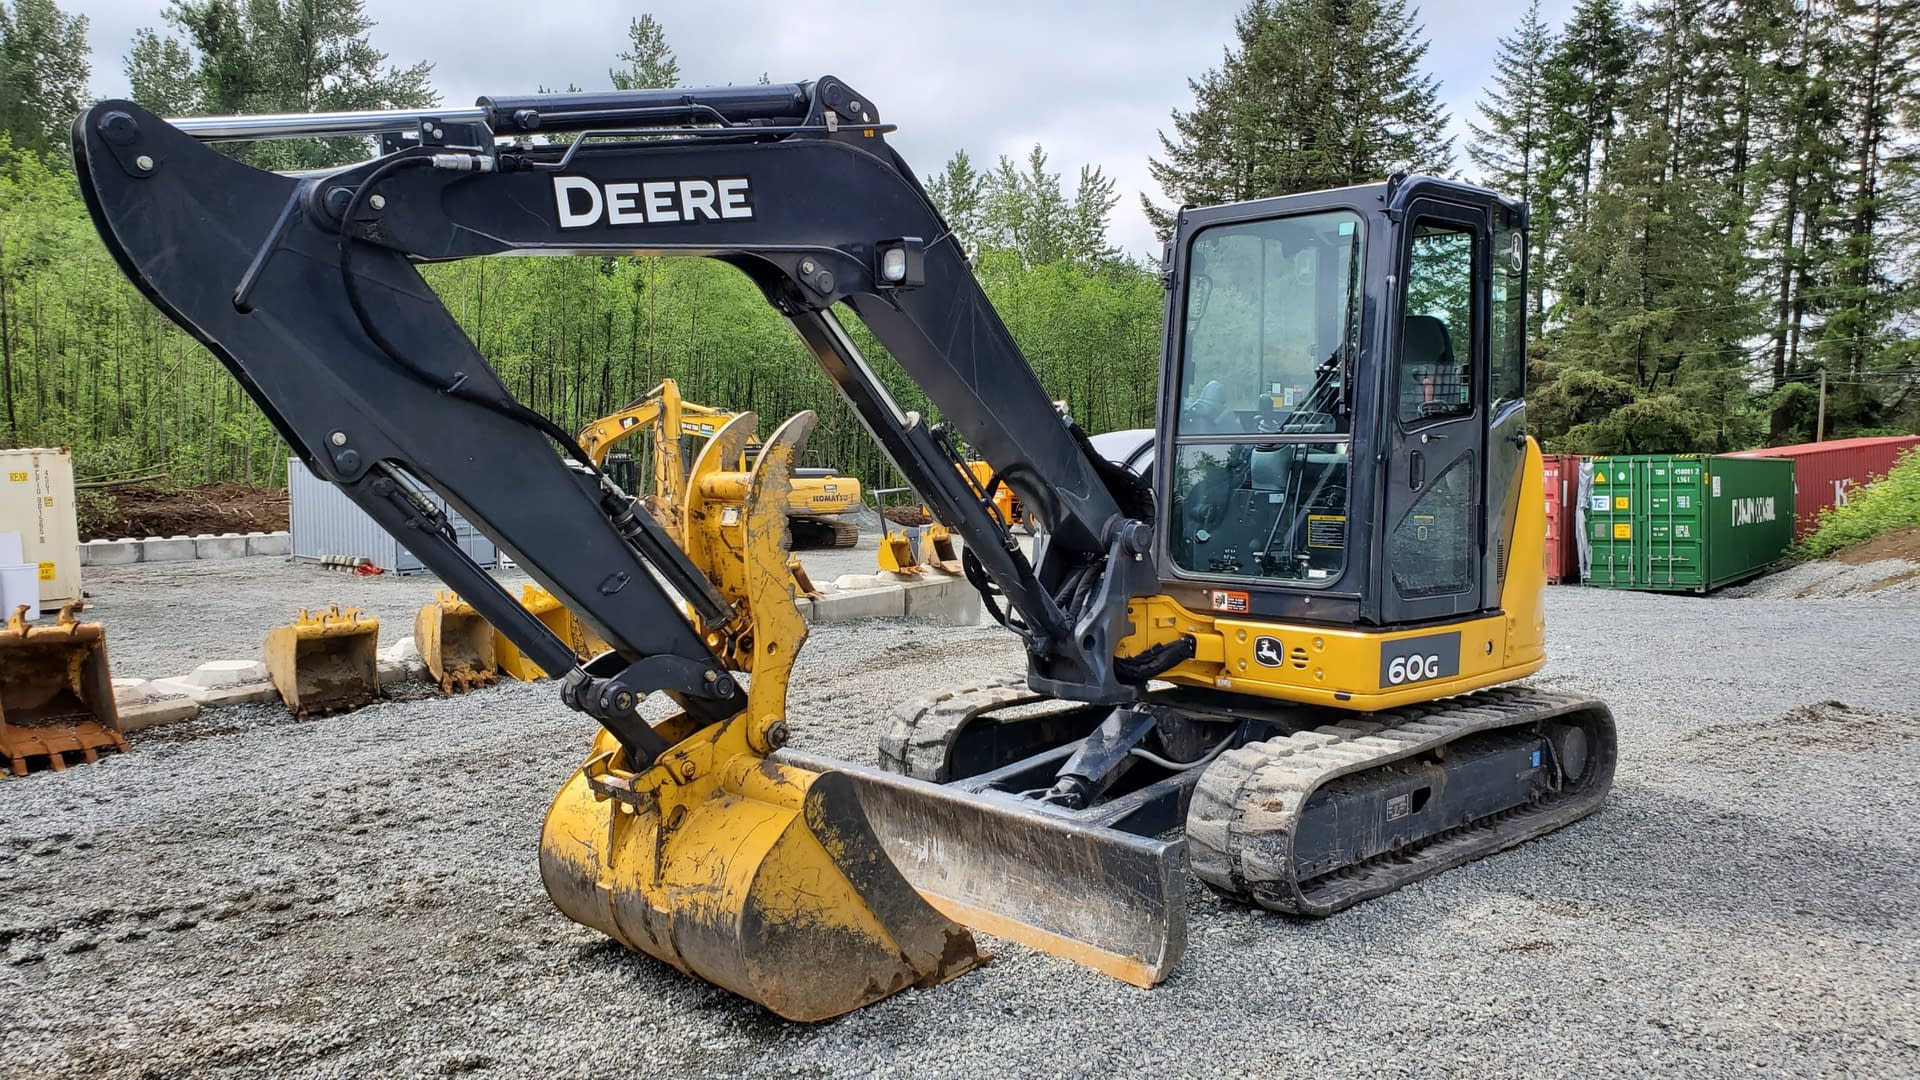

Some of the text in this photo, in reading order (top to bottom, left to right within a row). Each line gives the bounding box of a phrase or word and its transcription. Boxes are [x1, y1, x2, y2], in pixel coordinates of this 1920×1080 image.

[553, 176, 752, 228] DEERE
[812, 494, 849, 503] KOMATSU
[1388, 654, 1439, 685] 60G
